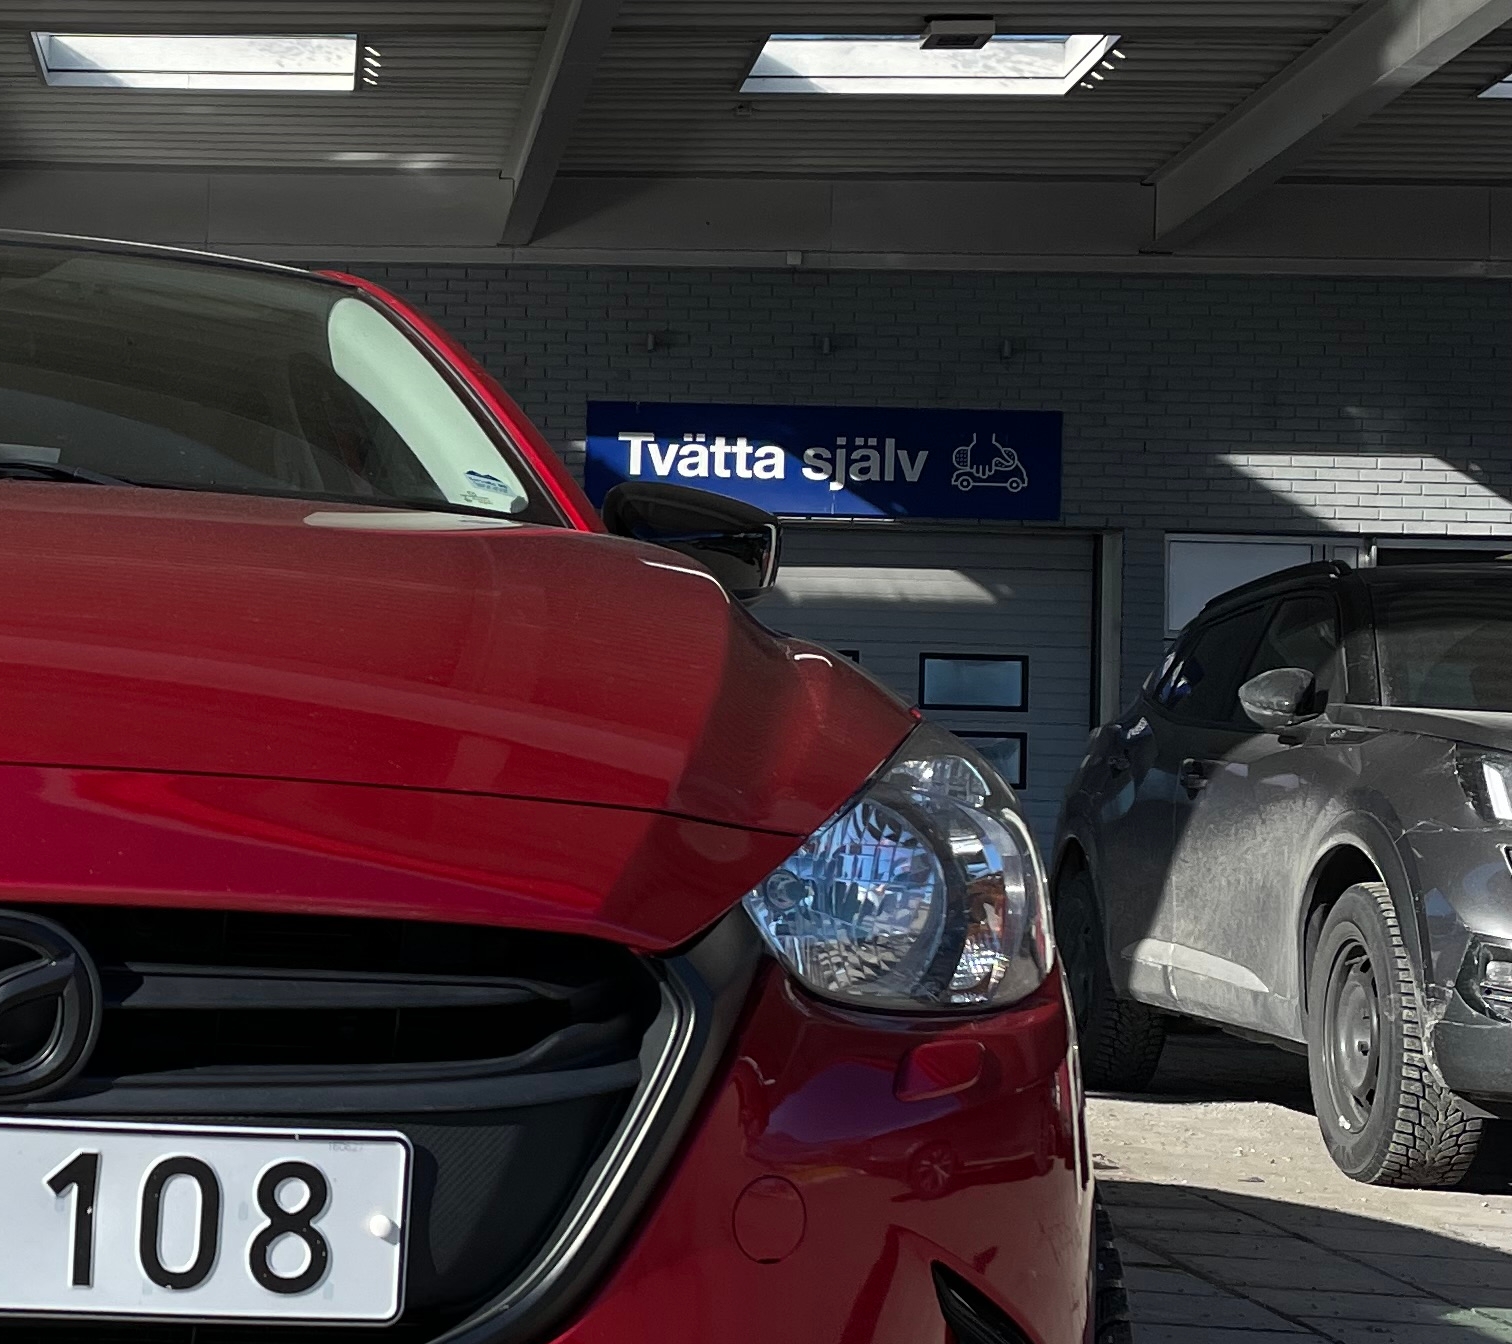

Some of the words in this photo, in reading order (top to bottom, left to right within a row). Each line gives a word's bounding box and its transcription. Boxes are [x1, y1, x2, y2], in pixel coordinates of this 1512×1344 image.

[618, 432, 785, 480] Tvätta
[801, 436, 929, 491] själv
[46, 1151, 329, 1295] 108
